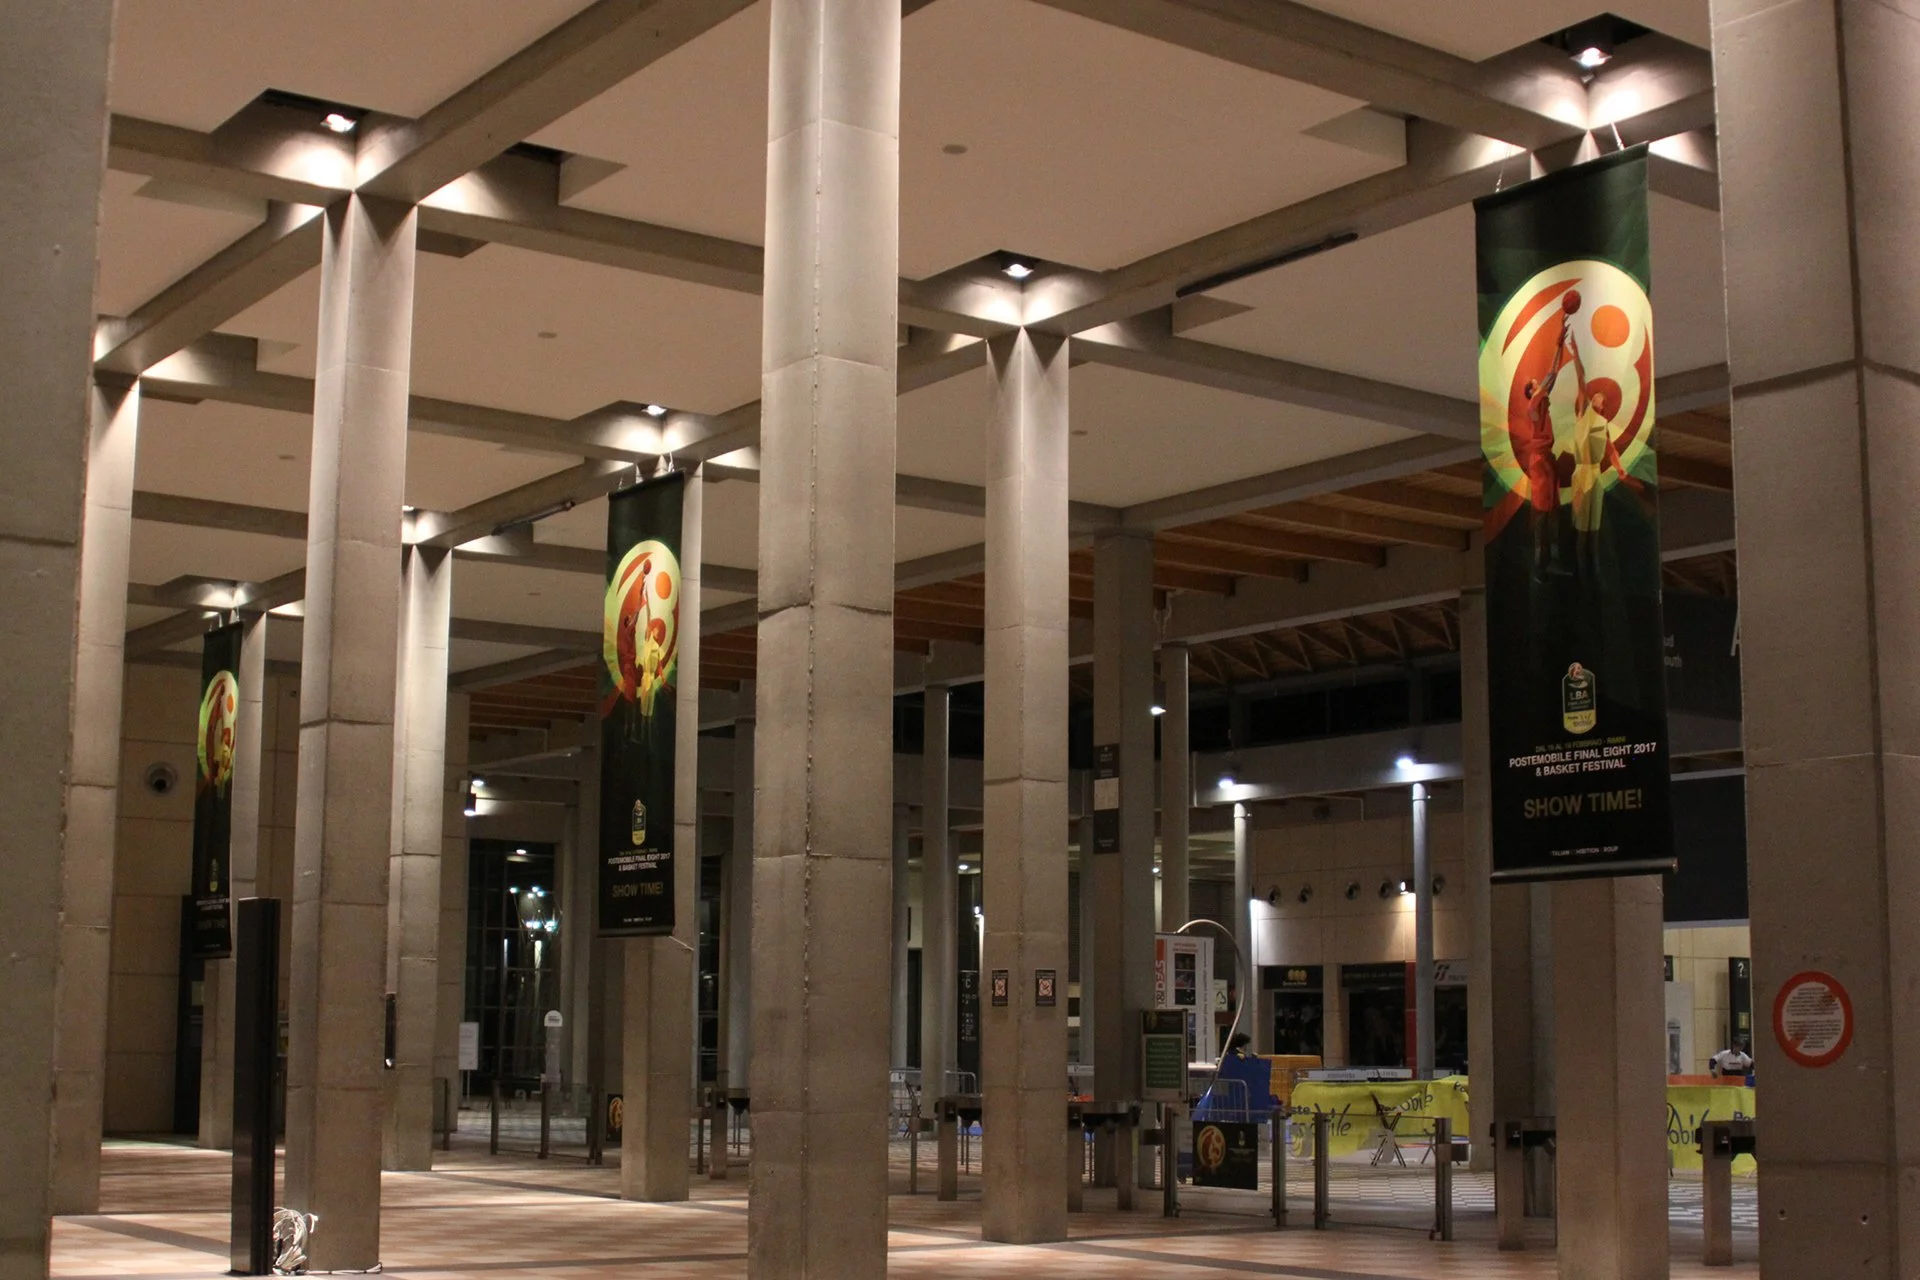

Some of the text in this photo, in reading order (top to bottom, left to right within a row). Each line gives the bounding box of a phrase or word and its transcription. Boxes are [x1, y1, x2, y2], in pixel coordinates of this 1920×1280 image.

[1509, 742, 1657, 768] POSTEMOBILE FINAL EIGHT 2017
[1535, 758, 1626, 777] & BASKET FESTIVAL
[1524, 788, 1643, 819] SHOW TIME!
[612, 883, 638, 898] SHOW
